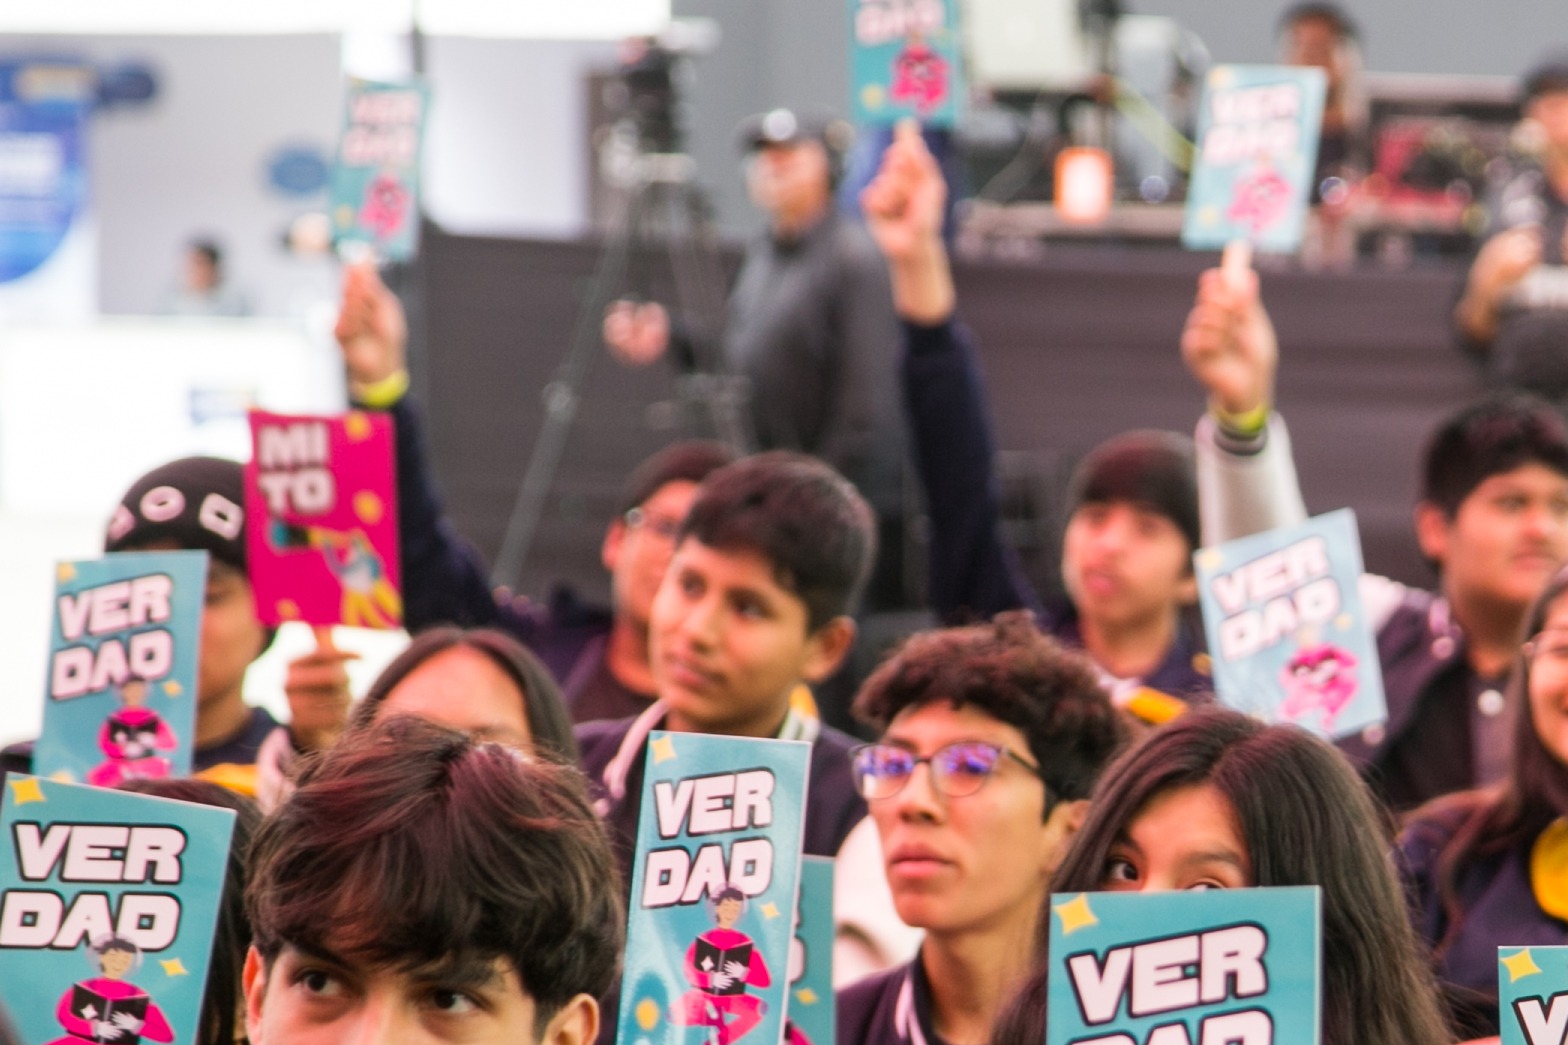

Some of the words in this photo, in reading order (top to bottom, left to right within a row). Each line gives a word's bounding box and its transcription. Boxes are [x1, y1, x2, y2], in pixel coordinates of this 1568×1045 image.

[257, 421, 332, 469] MI
[257, 466, 337, 515] TO
[57, 573, 173, 641] VER
[1210, 534, 1330, 616] VER
[1218, 575, 1342, 663] DAD
[50, 629, 173, 700] DAD
[653, 766, 776, 840] VER
[12, 820, 189, 885] VER
[641, 836, 775, 910] DAD
[0, 888, 182, 952] DAD
[1065, 921, 1269, 1027] VER
